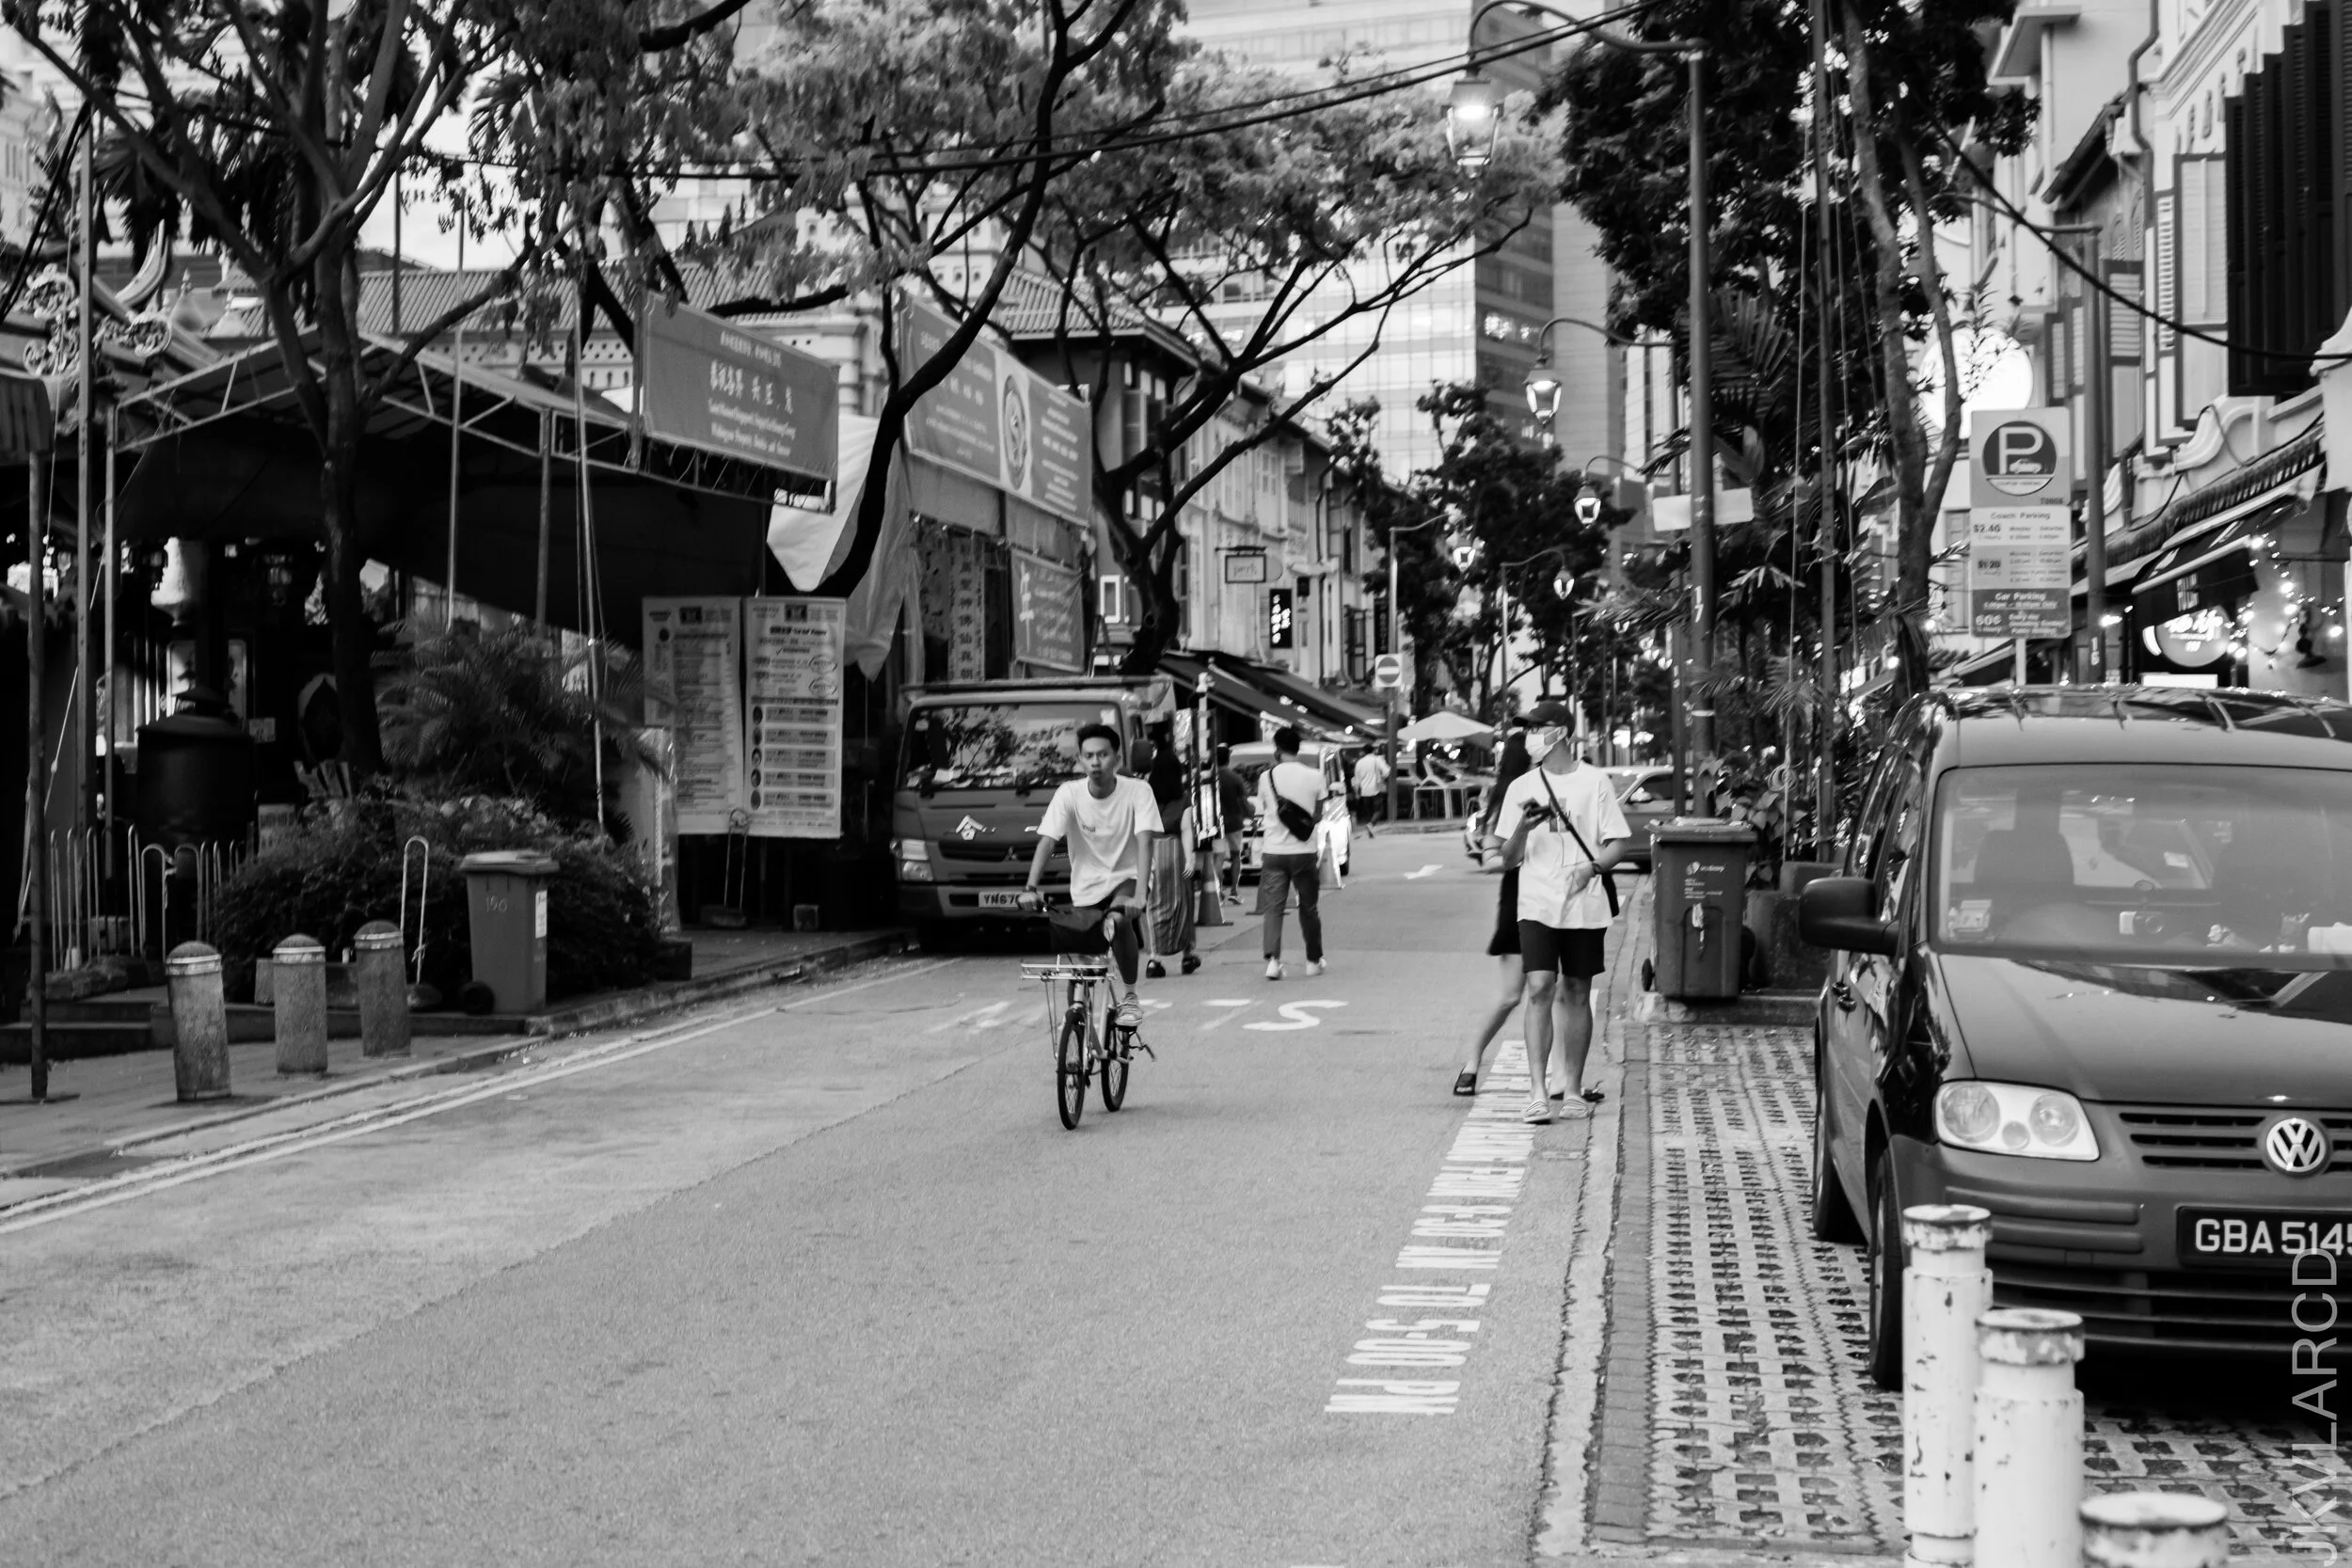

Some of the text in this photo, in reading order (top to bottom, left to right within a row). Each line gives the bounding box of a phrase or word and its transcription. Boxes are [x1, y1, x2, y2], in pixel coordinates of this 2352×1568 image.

[1998, 426, 2044, 475] P
[1995, 591, 2046, 601] Car Parking
[2090, 636, 2100, 666] 16
[983, 895, 1018, 907] YN67
[1426, 1165, 1526, 1197] FROM
[1411, 1204, 1513, 1238] 8-30
[2195, 1218, 2352, 1256] GBA514
[1395, 1245, 1502, 1269] AM
[1375, 1283, 1491, 1307] TO
[1345, 1319, 1481, 1367] 5-00
[1324, 1378, 1461, 1415] PM
